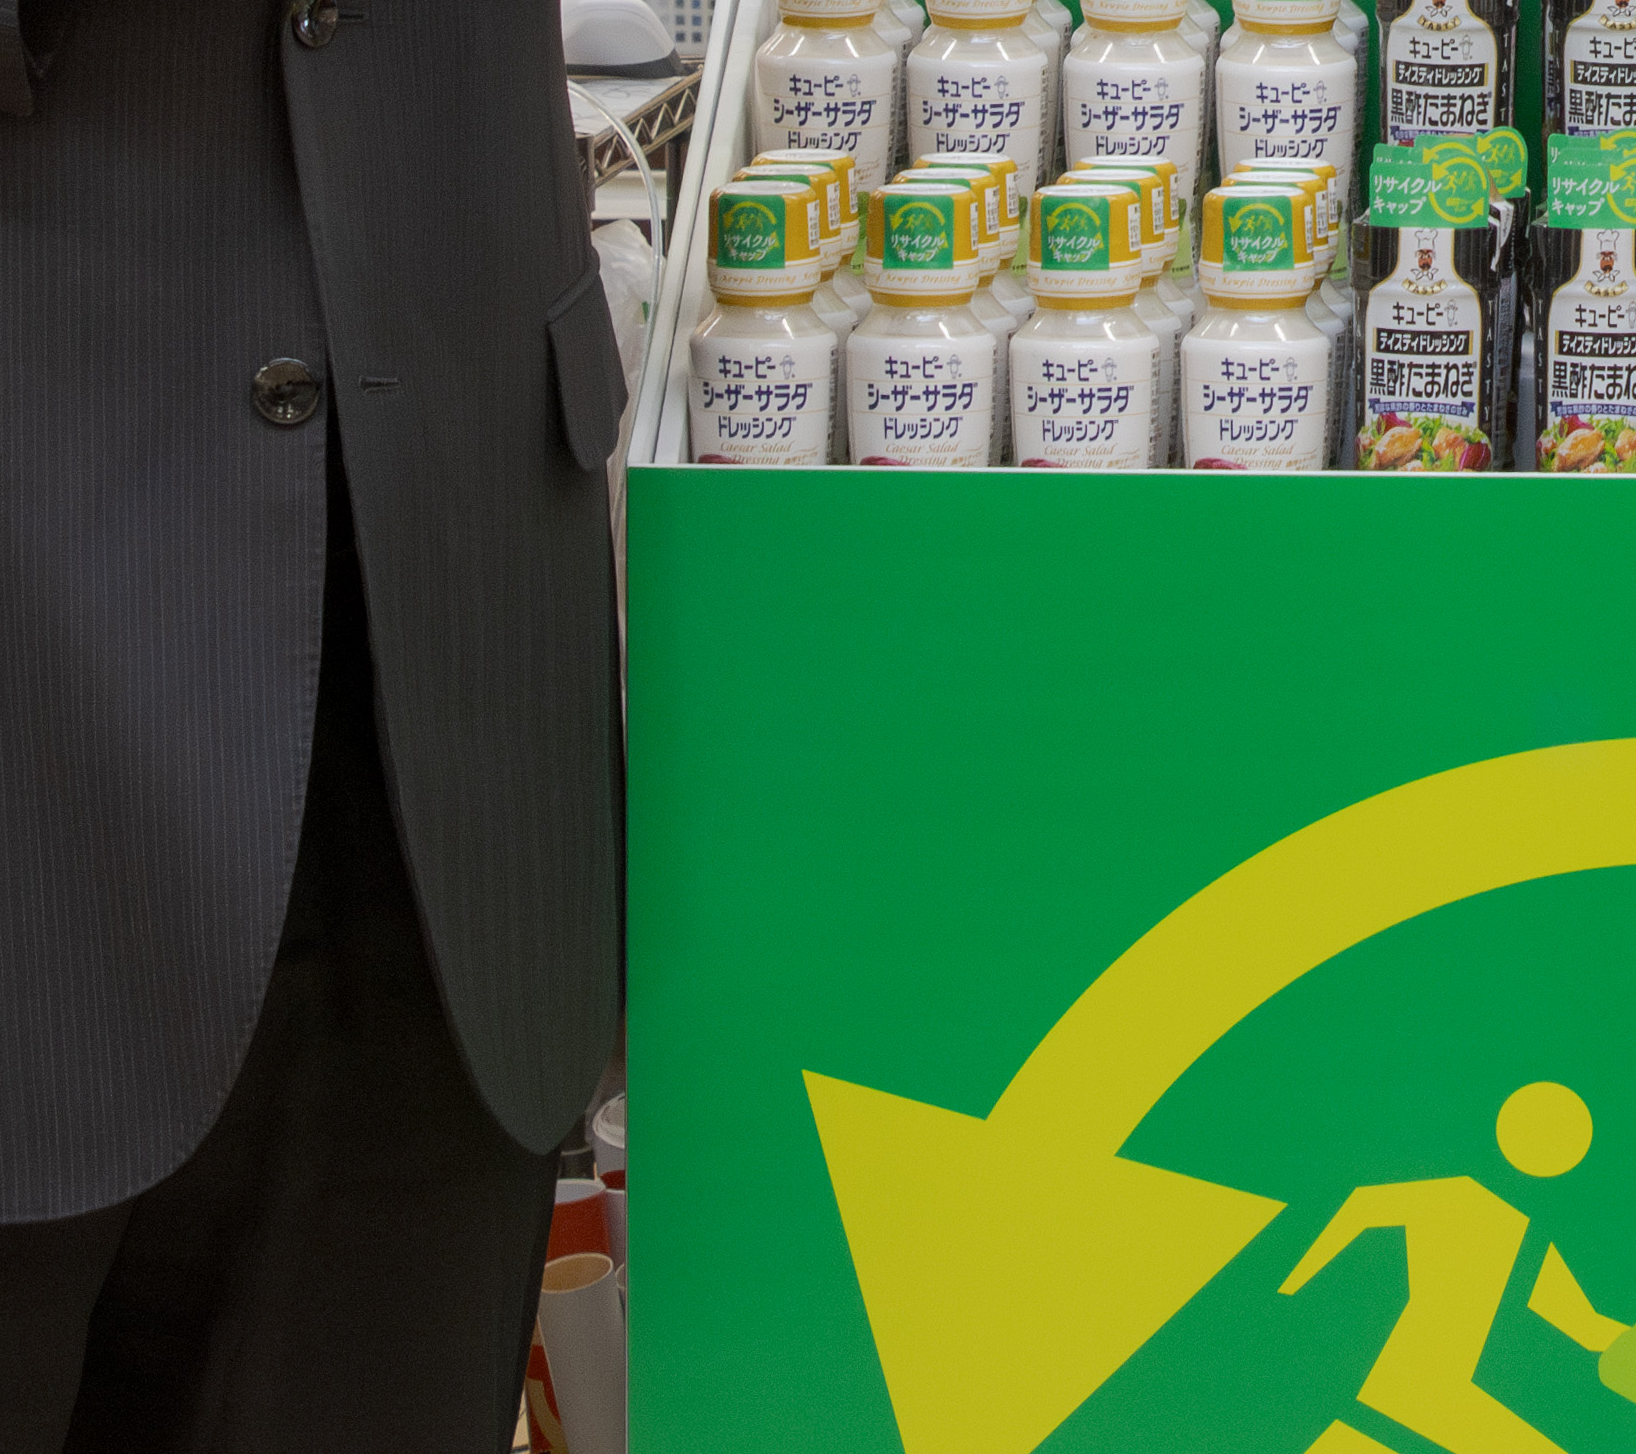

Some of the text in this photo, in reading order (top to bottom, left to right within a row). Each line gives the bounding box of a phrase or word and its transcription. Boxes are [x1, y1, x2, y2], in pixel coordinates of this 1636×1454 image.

[1409, 38, 1461, 60] キューピー
[789, 73, 844, 97] キューピー
[773, 100, 877, 128] シーザーサラダ
[1390, 91, 1493, 129] 黒酢たまねぎ
[1372, 175, 1442, 198] リサイクル
[1372, 196, 1425, 217] キャップ
[1391, 304, 1443, 326] キューピー
[1380, 332, 1466, 354] テイスティドレッシング
[718, 354, 777, 380] キューピー
[884, 355, 943, 380] キューピー
[1220, 357, 1280, 382] キューピー
[1370, 358, 1476, 401] 黒酢たまねぎ
[702, 382, 813, 410] シーザーサラダ
[866, 382, 979, 410] シーザーサラダ
[1202, 383, 1314, 413] シーザーサラダ
[716, 415, 797, 441] ドレッシング
[883, 415, 964, 441] ドレッシング
[1218, 417, 1299, 443] ドレッシング
